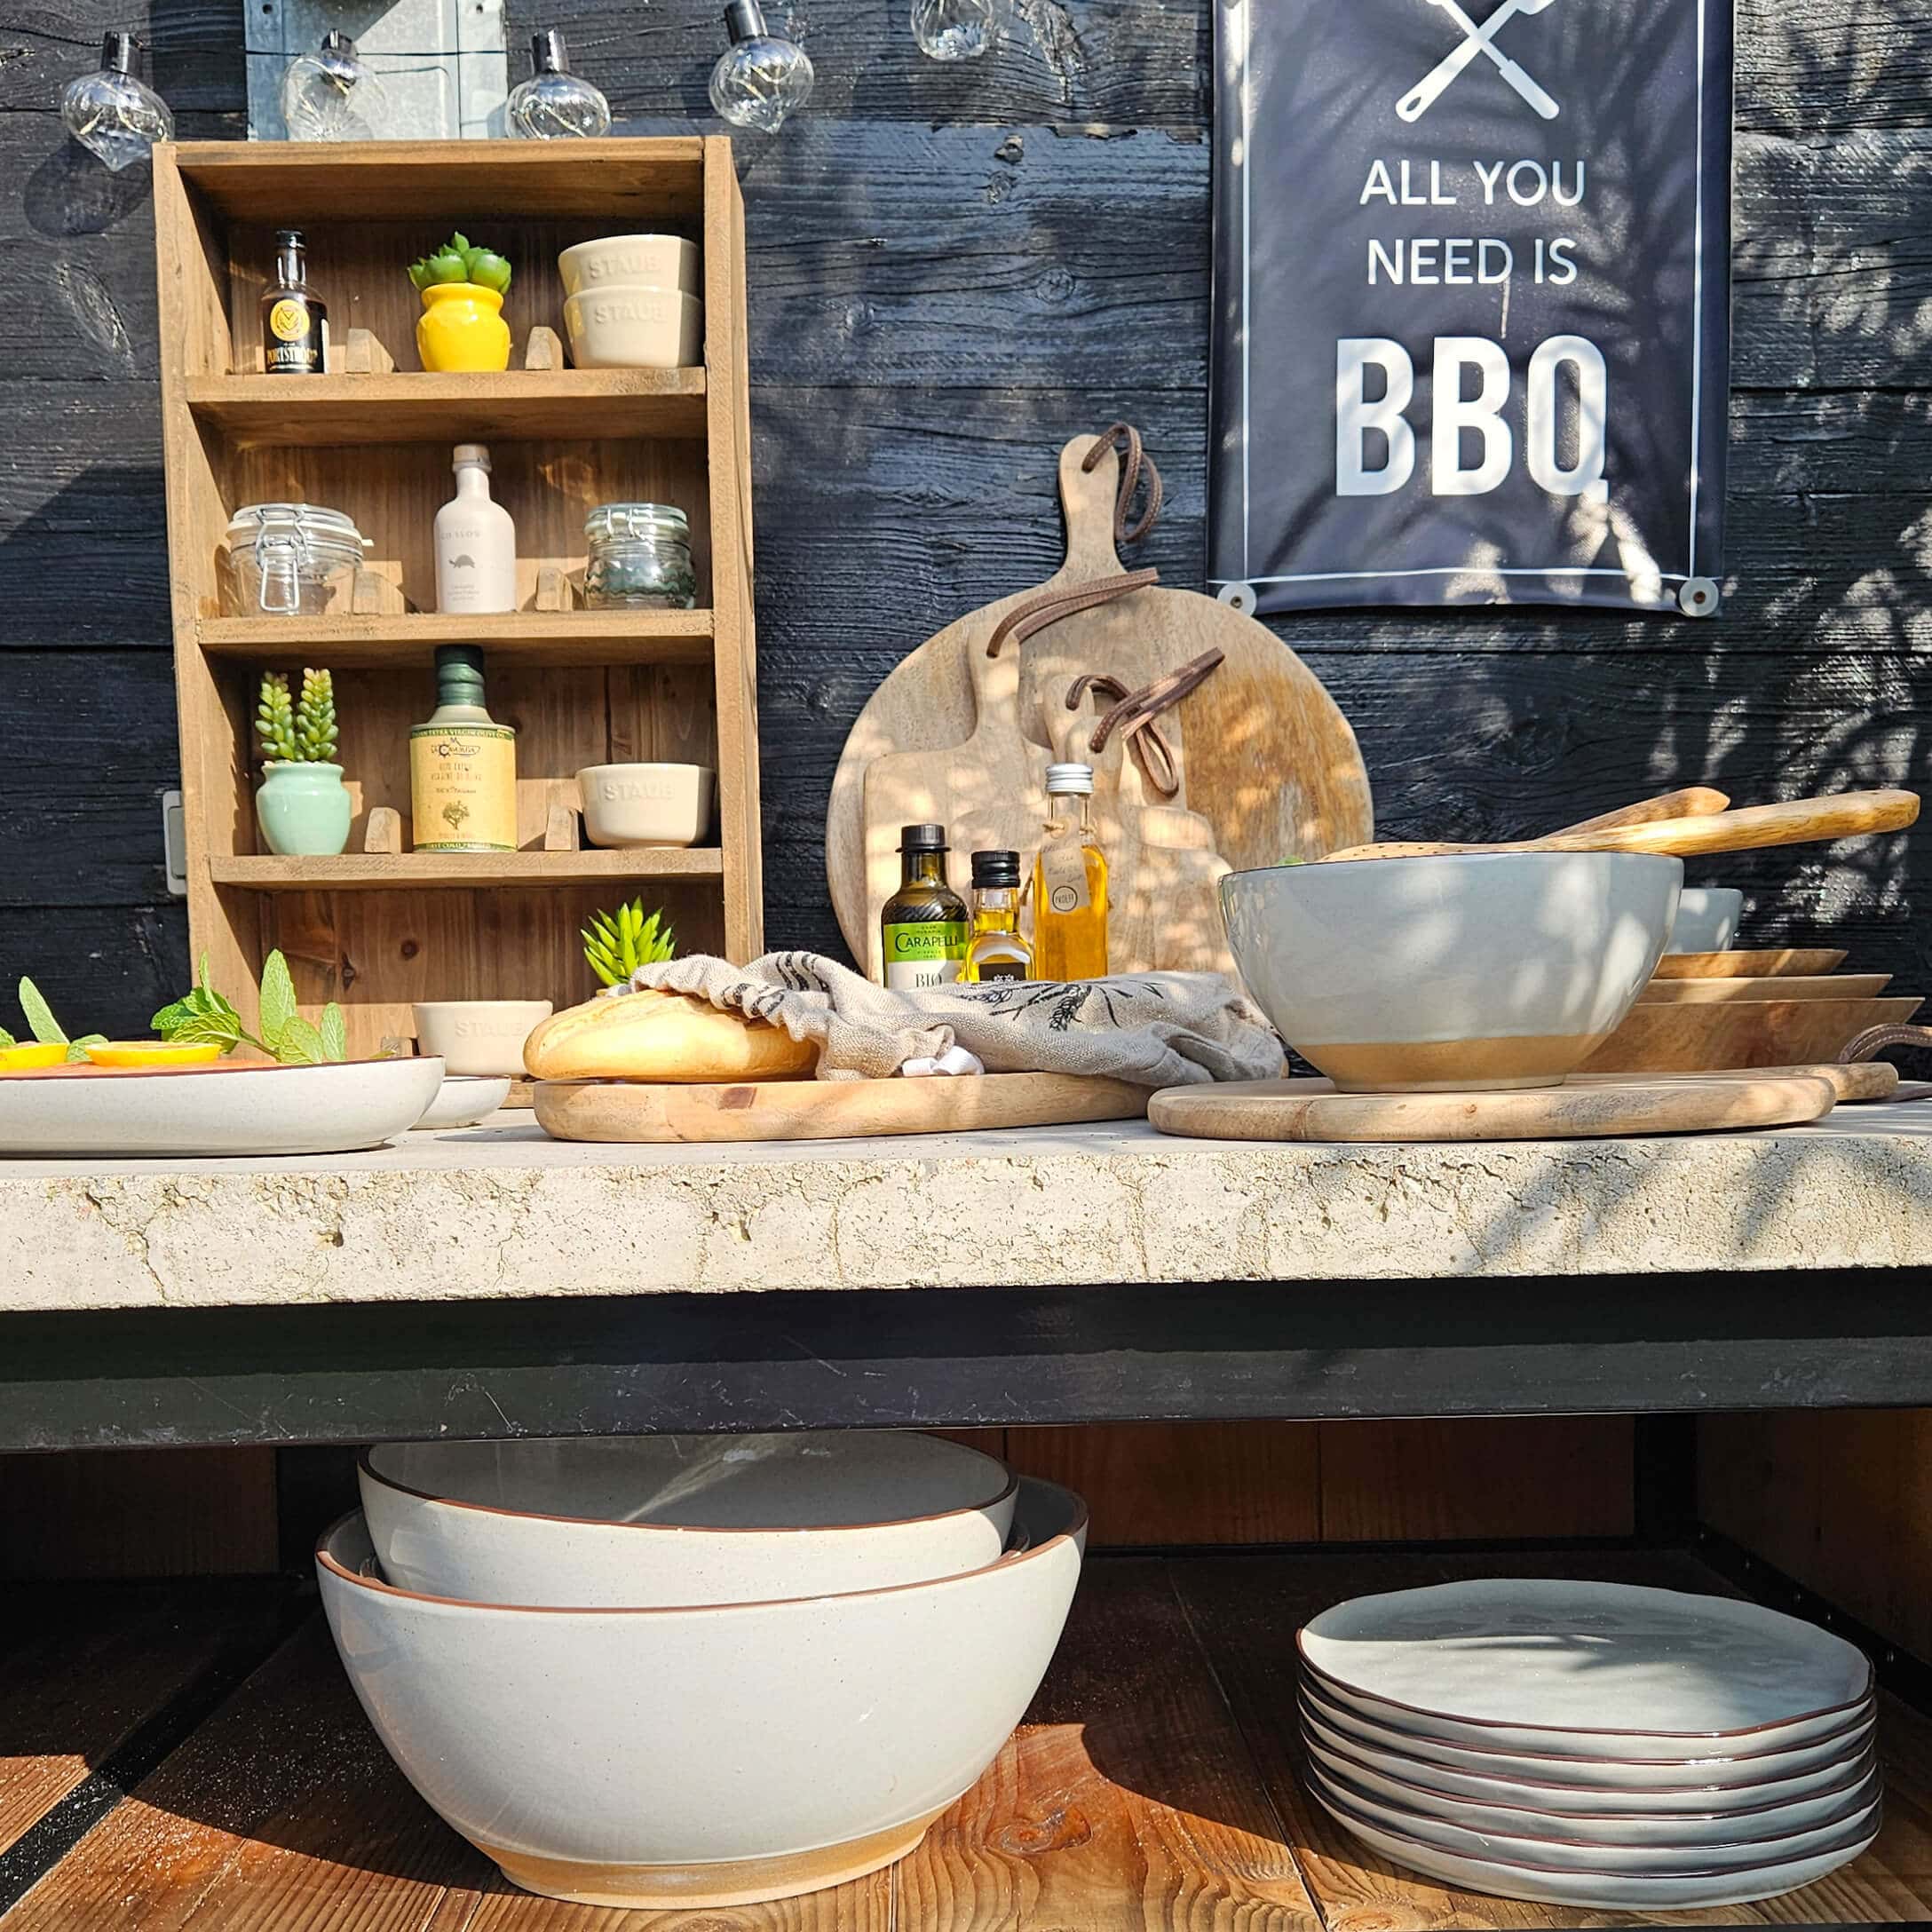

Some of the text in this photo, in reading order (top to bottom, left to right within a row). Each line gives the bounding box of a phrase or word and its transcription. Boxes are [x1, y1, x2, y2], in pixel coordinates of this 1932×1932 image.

[1359, 159, 1586, 207] ALL YOU
[589, 254, 661, 280] STAUB
[1367, 237, 1578, 286] NEED IS
[595, 301, 669, 325] STAUB
[1335, 334, 1609, 503] BBQ
[604, 781, 675, 801] STAUB
[895, 932, 958, 953] CARAPELLI
[915, 972, 943, 988] BIO
[455, 1021, 527, 1037] STAUB
